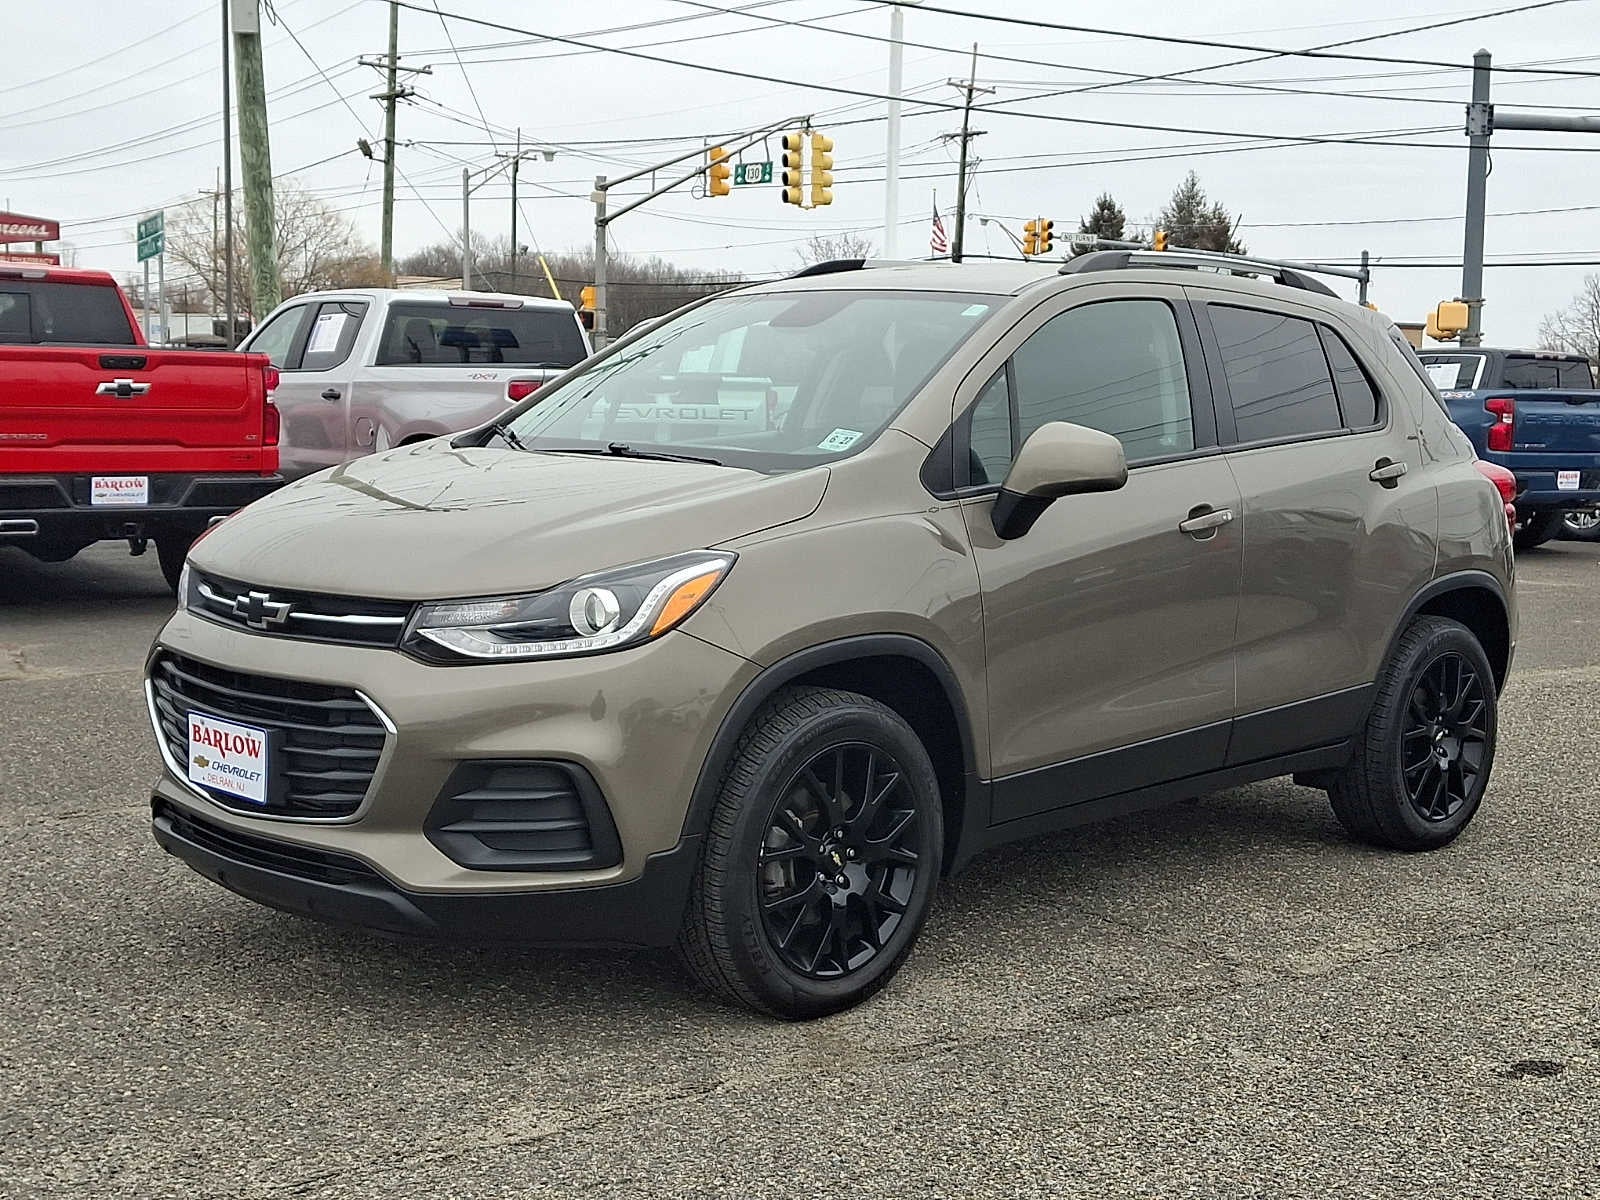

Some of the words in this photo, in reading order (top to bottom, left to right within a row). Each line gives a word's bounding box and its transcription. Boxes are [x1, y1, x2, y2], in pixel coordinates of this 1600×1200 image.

[747, 168, 760, 179] 130
[94, 480, 143, 491] BARLOW
[192, 723, 262, 760] BARLOW
[211, 760, 261, 782] CHEVROLET
[236, 782, 245, 792] NJ
